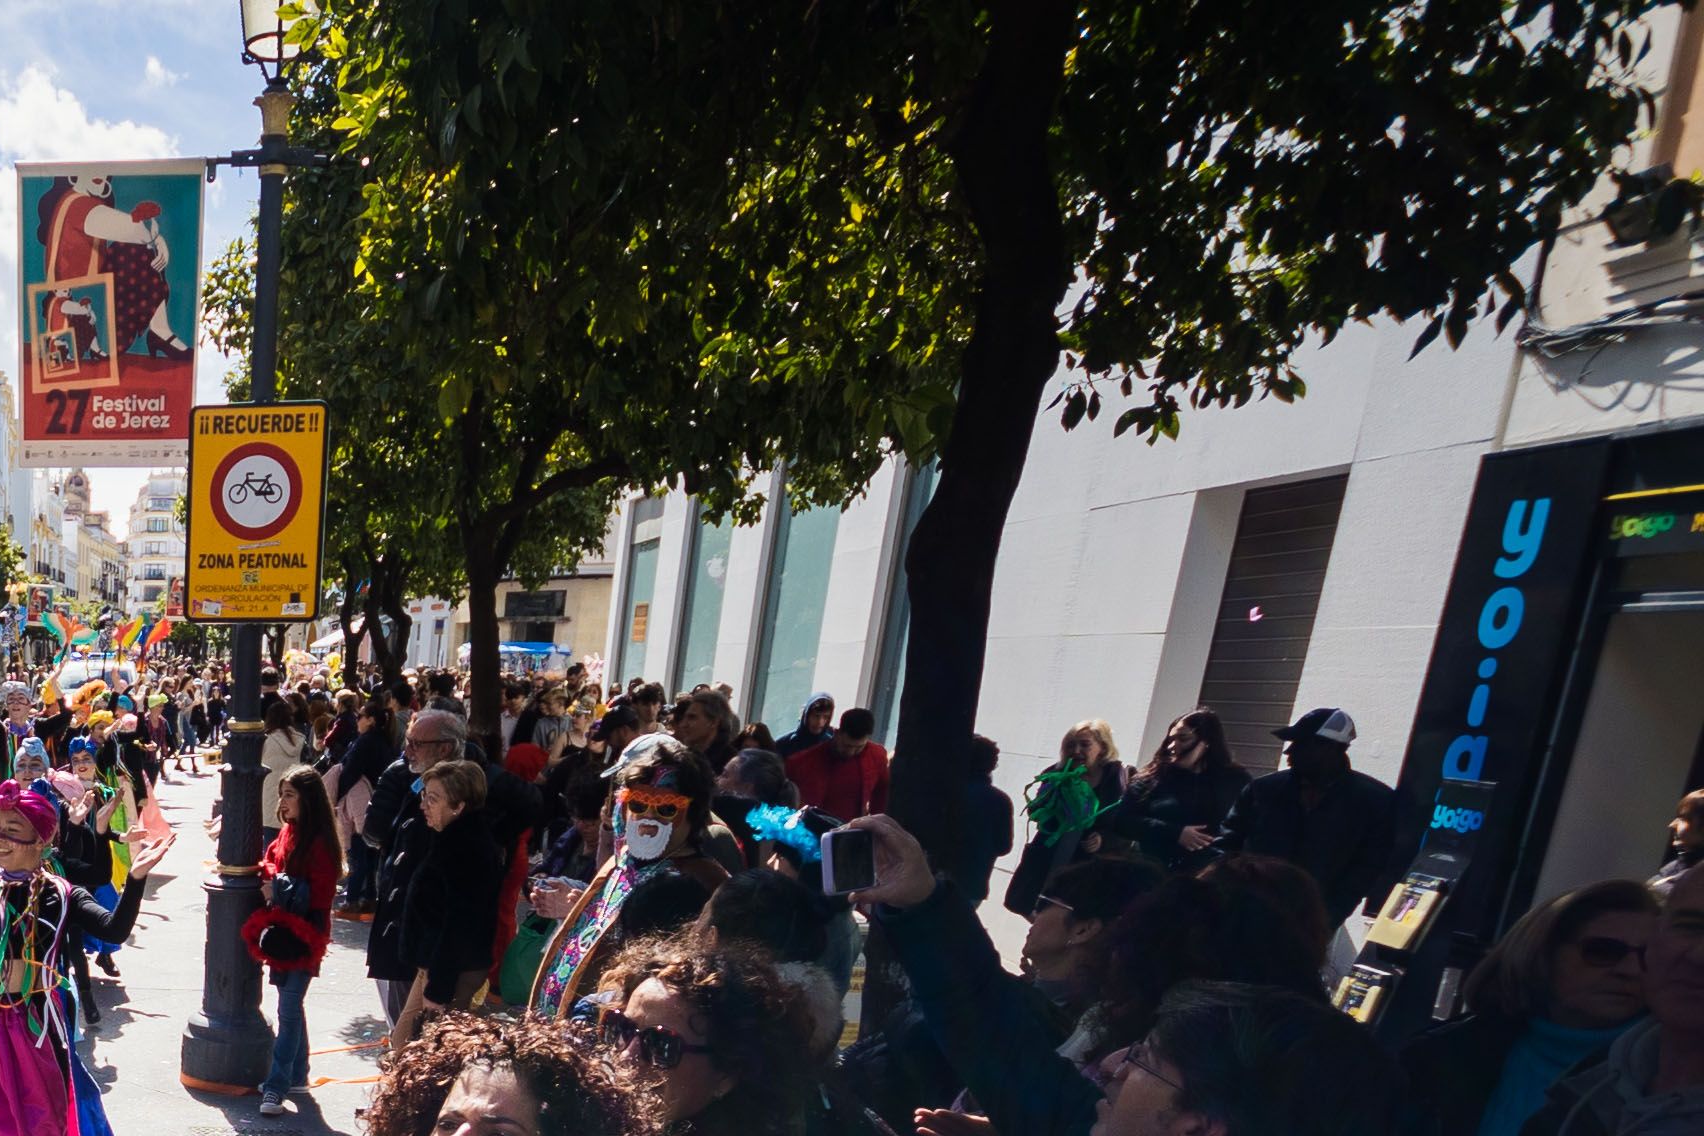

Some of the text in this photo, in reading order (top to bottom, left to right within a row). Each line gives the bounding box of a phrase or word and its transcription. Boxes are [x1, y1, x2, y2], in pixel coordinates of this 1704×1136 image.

[44, 388, 93, 435] 27
[92, 394, 165, 412] Festival
[92, 414, 171, 429] de Jerez
[213, 413, 306, 434] RECUERDE
[1609, 512, 1675, 540] yoigo
[198, 552, 308, 569] ZONA PEATONAL
[249, 584, 295, 592] MUNICIPAL
[1429, 804, 1484, 834] yoigo
